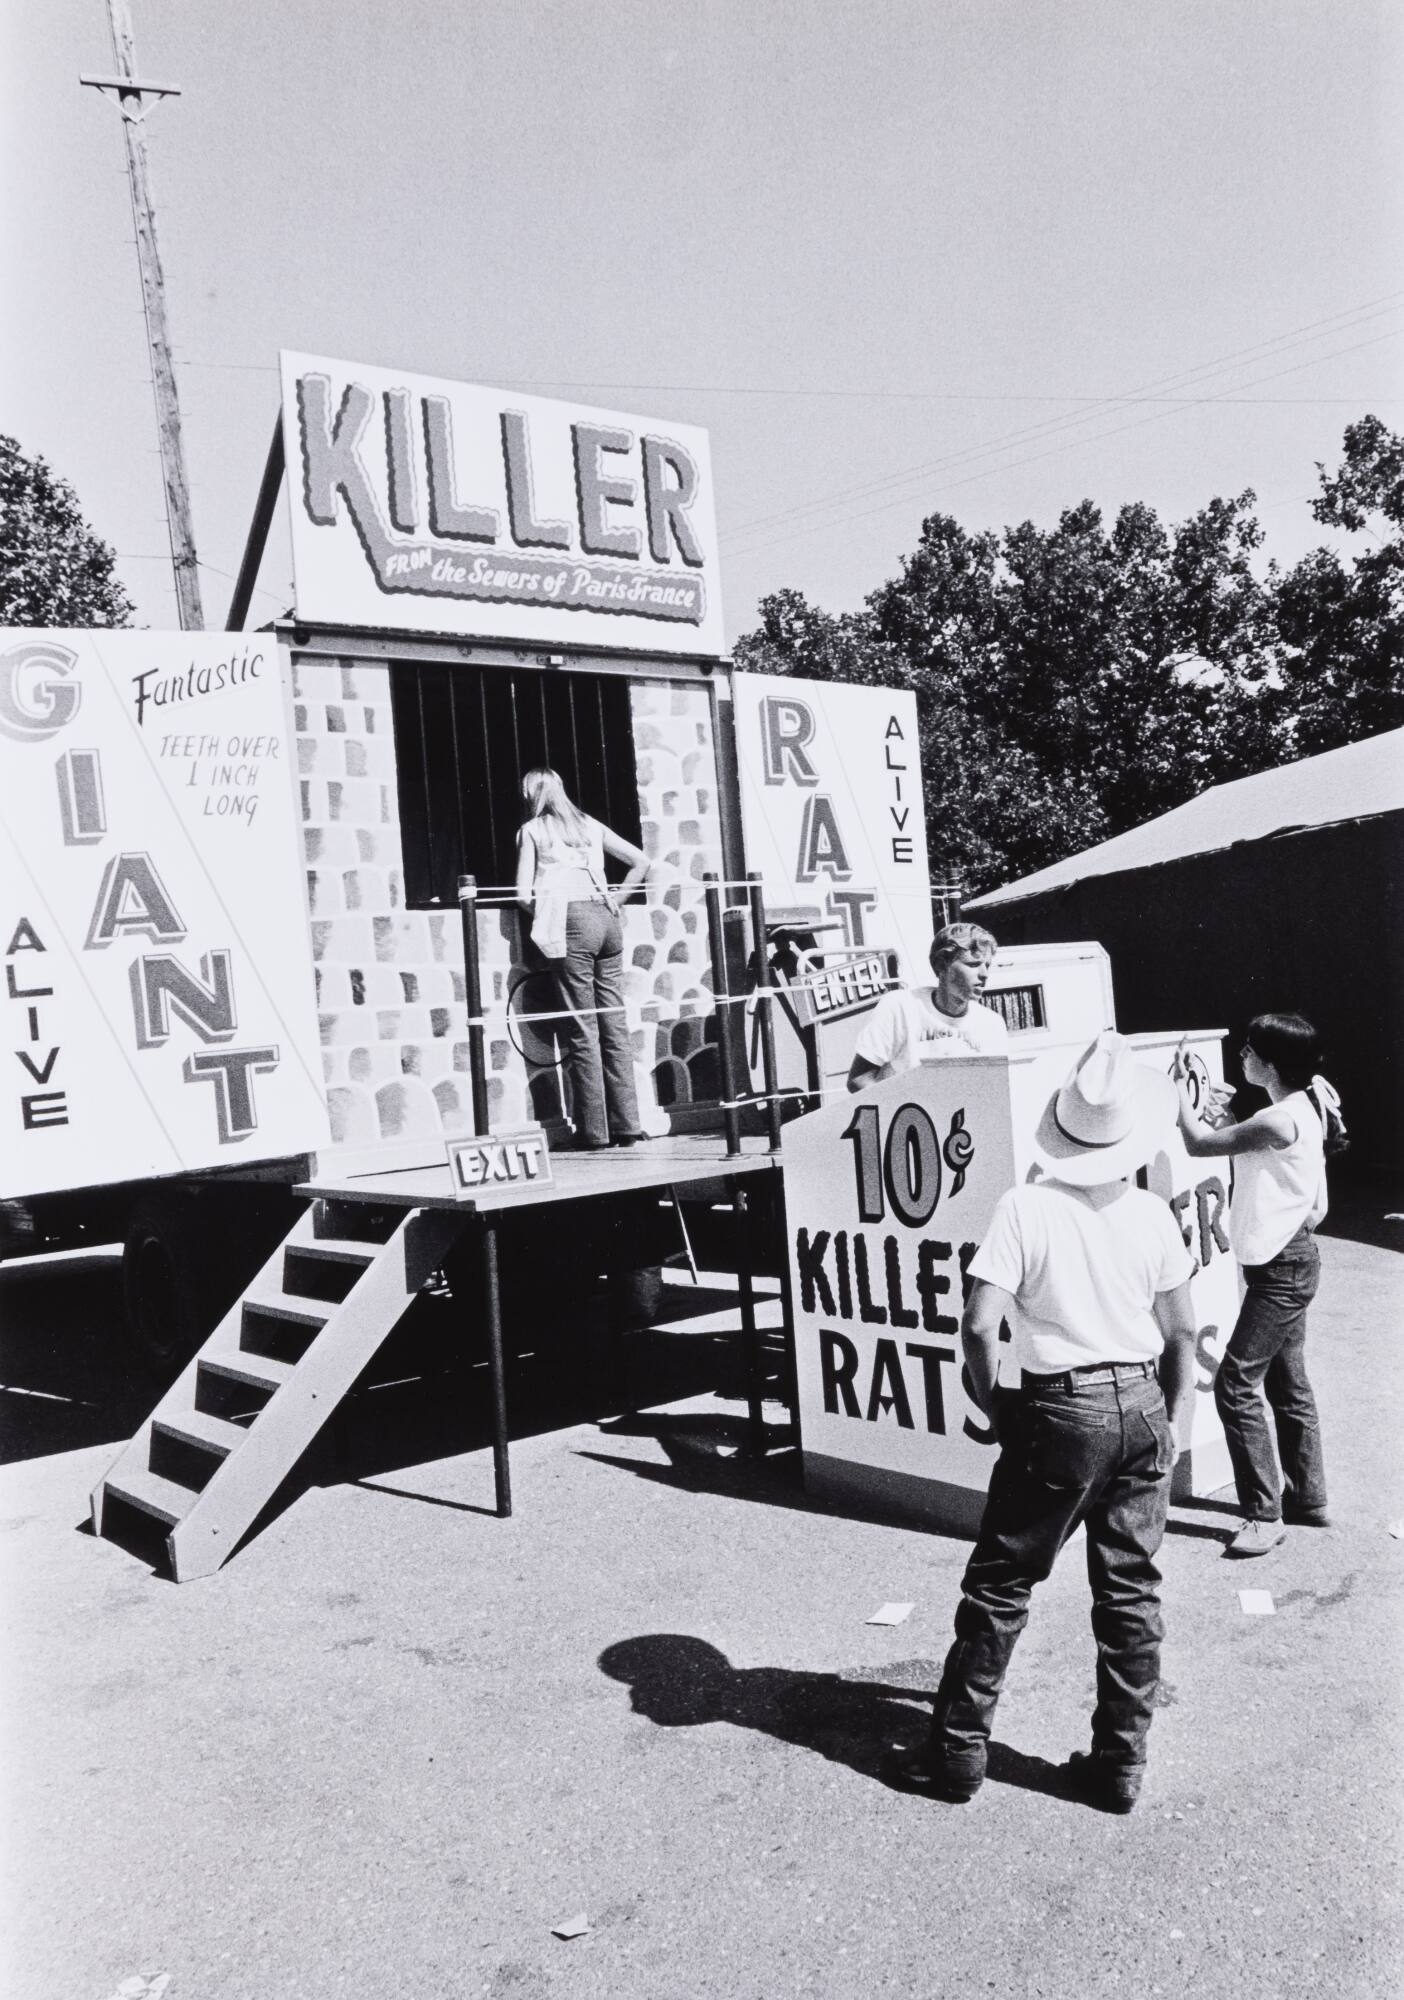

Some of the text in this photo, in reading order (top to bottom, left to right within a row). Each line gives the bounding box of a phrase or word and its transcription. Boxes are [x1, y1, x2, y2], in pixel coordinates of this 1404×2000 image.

[296, 372, 705, 568] KILLER
[386, 548, 696, 608] FROM the Sewers of Paris France
[132, 645, 264, 728] Fantastic
[160, 734, 280, 760] TEETH OVER
[210, 764, 259, 787] INCH
[203, 794, 259, 827] LONG
[758, 694, 879, 957] RAT
[884, 715, 913, 863] ALIVE
[0, 640, 280, 1144] GIANT
[6, 916, 70, 1130] ALIVE
[810, 958, 888, 1015] ENTER
[456, 1141, 542, 1188] EXIT
[841, 1102, 975, 1228] 10¢
